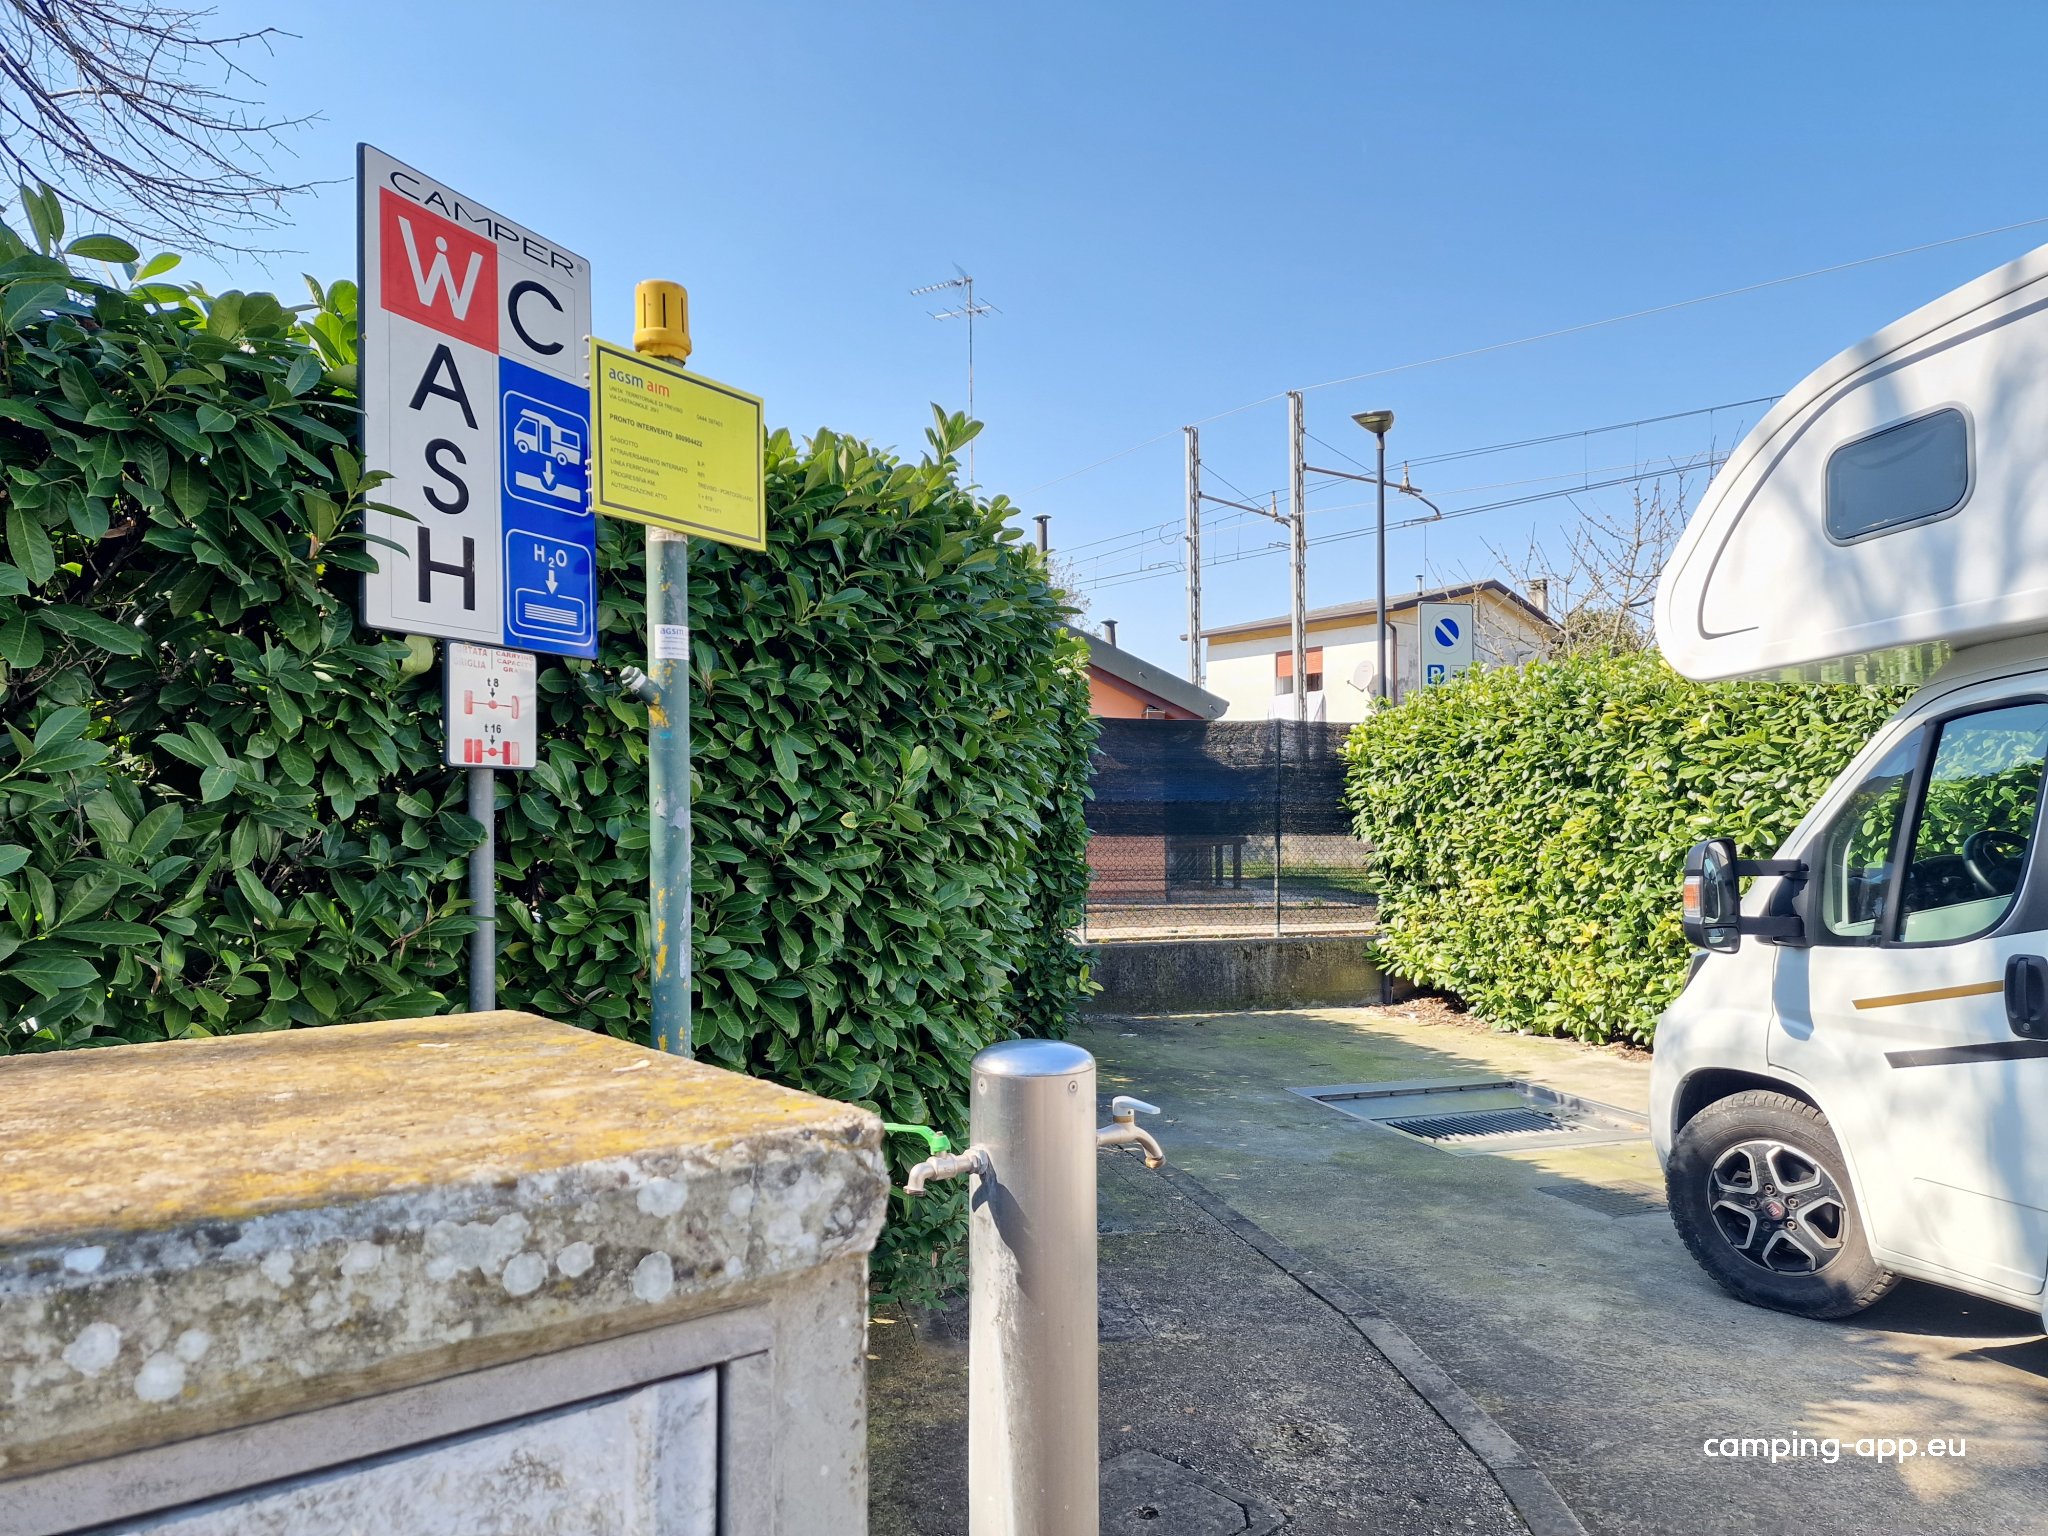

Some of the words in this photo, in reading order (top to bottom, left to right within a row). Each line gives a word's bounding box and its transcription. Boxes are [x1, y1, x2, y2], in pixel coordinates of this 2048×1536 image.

[390, 171, 575, 279] CAMPER
[647, 380, 670, 398] aim
[609, 412, 635, 428] PRONTO
[636, 420, 673, 439] INTERVENTO
[610, 434, 639, 449] GASDOTTO
[610, 446, 660, 467] ATTRAVERSAMENTO
[661, 461, 688, 474] INTERRATO
[610, 458, 625, 468] LINEA
[626, 462, 660, 477] FERROVIARIA
[610, 481, 654, 498] AUTORIZZAZIONE
[655, 491, 668, 501] ATTO
[454, 645, 488, 656] RTATA
[493, 678, 499, 687] 8
[491, 724, 502, 734] 16
